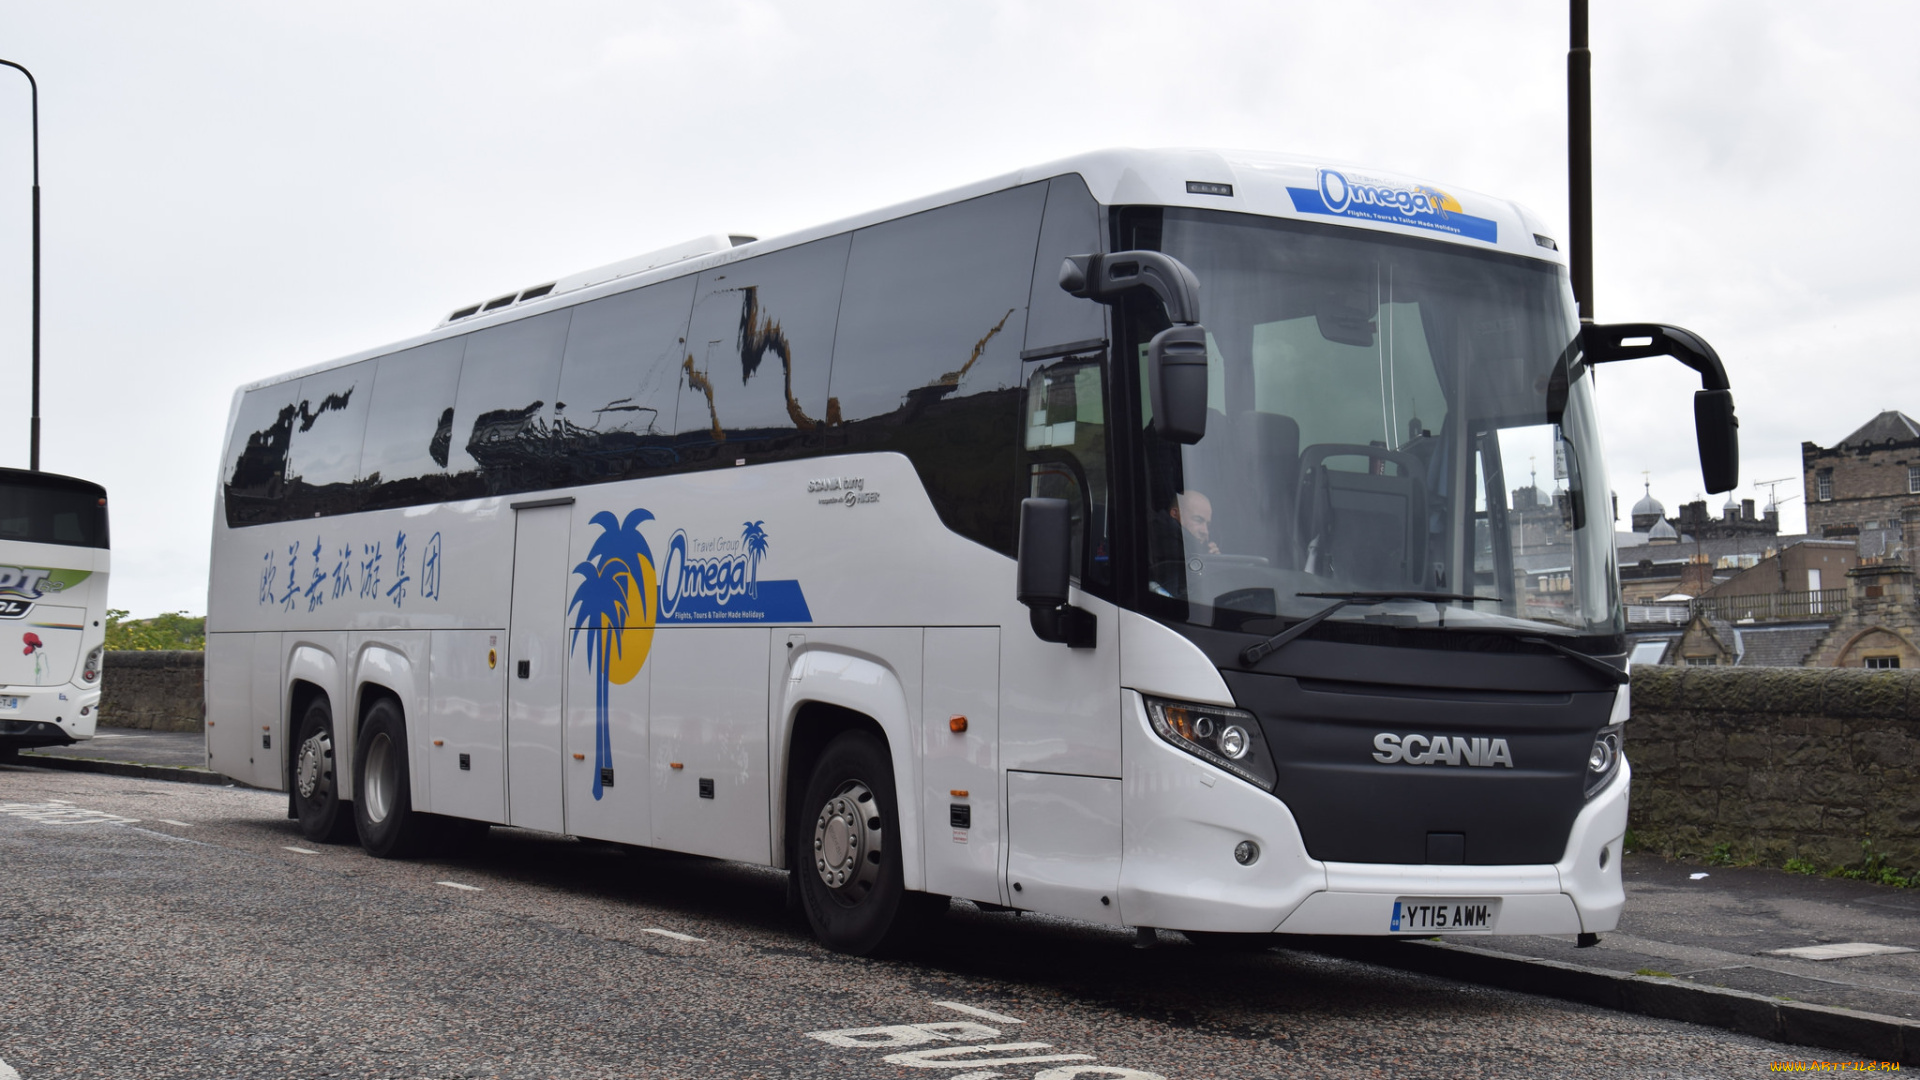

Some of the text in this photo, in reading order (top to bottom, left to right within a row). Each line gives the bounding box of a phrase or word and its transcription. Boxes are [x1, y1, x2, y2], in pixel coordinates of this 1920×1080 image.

[1317, 168, 1433, 215] Omega
[1373, 213, 1391, 221] Tours
[1399, 217, 1416, 225] Tailor
[1435, 223, 1461, 233] Holidays
[693, 536, 740, 556] Travel Group
[661, 529, 748, 618] Omega
[693, 611, 707, 619] Tours
[712, 611, 727, 619] Tailor
[728, 611, 741, 619] Made
[742, 610, 765, 620] Holidays
[1372, 733, 1513, 768] SCANIA
[1407, 905, 1487, 927] YT15 AWM
